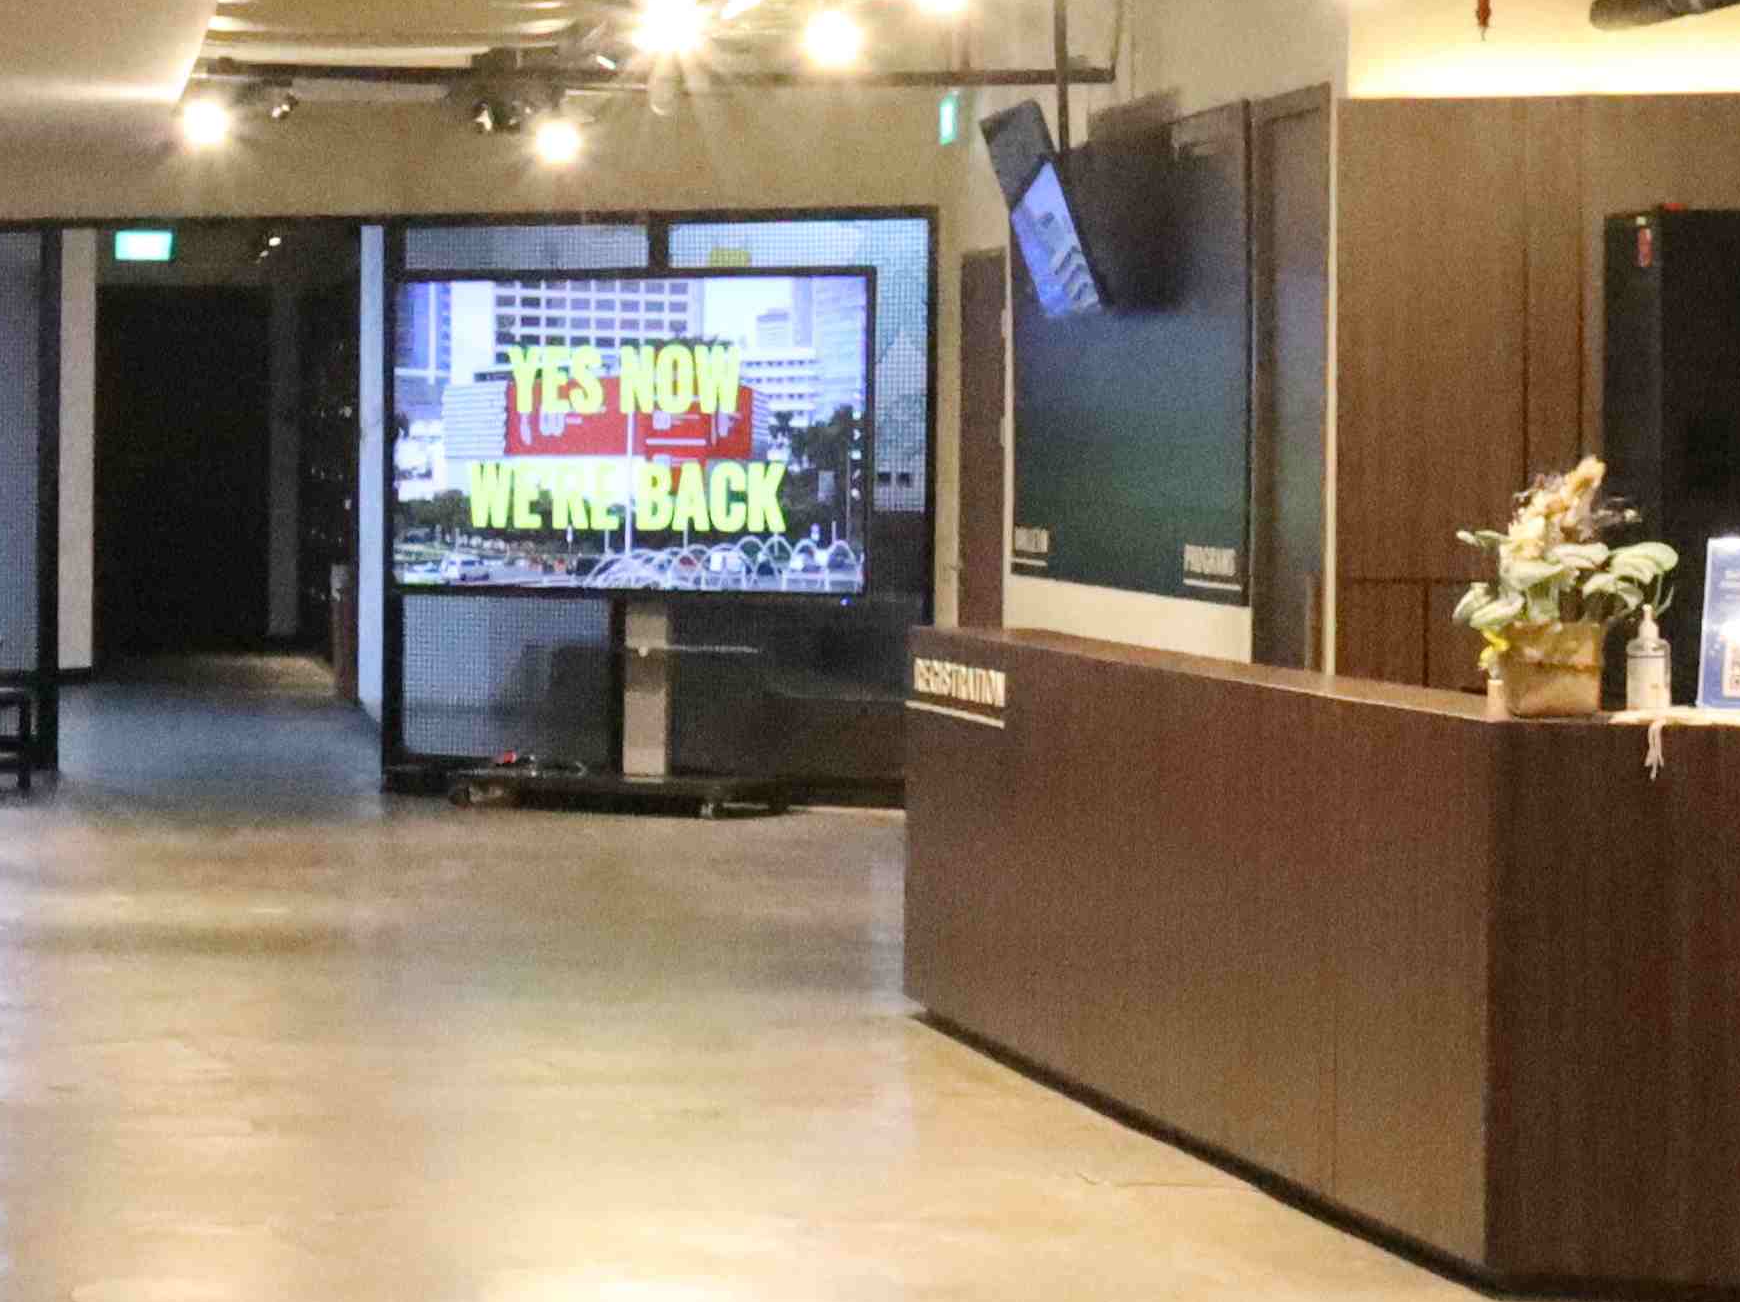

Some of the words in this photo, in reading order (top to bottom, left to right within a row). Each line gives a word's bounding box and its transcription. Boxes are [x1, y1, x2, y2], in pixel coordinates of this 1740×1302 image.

[508, 344, 604, 414] YES
[620, 343, 739, 414] NOW
[635, 460, 788, 533] BACK
